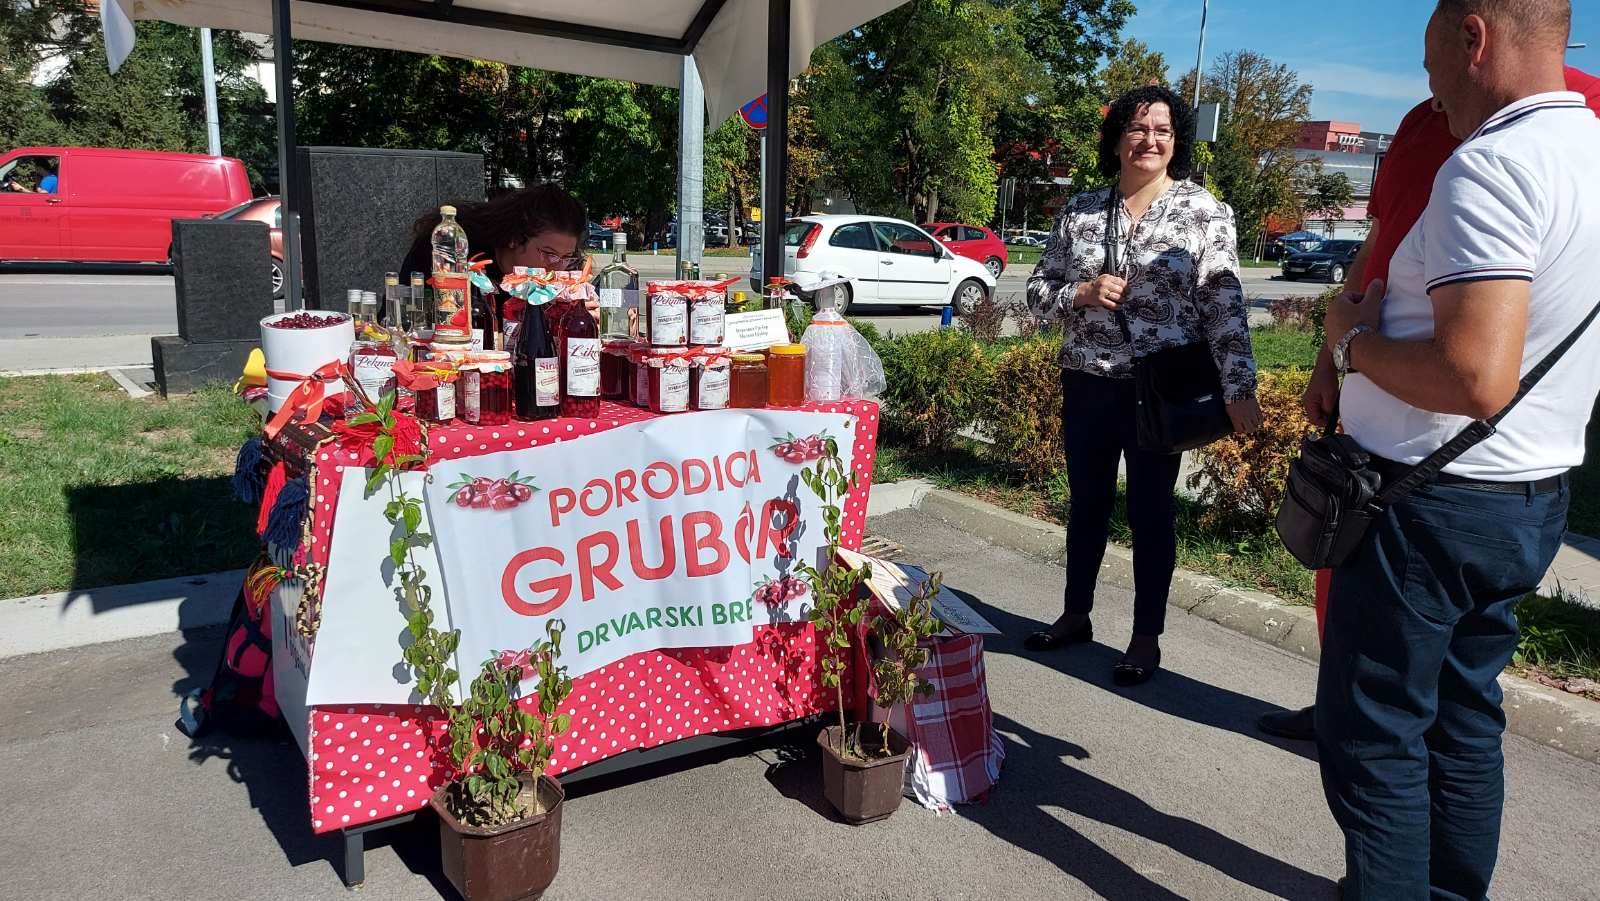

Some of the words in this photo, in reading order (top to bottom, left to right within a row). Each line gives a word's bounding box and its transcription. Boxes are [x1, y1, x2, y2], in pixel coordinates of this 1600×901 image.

[548, 449, 761, 527] PORODICA
[501, 499, 800, 617] GRUBOR
[577, 605, 704, 654] DRVARSKI
